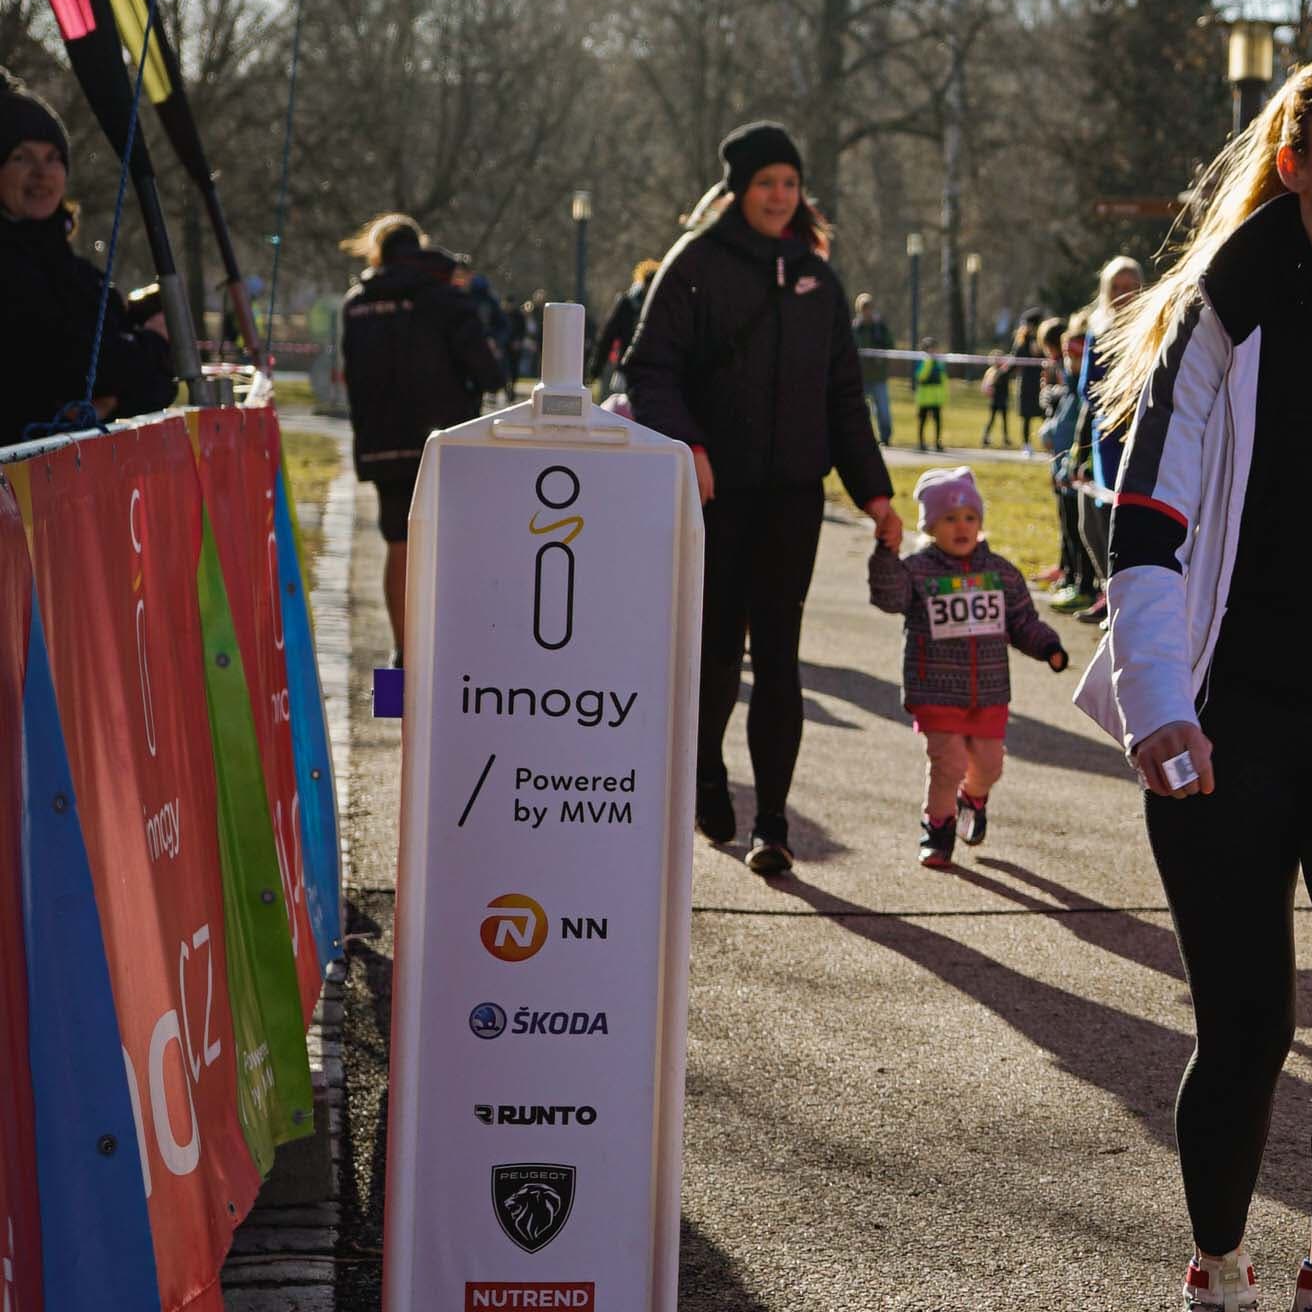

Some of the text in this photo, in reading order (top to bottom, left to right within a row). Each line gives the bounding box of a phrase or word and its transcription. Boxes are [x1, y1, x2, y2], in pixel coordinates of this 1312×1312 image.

[932, 594, 999, 625] 3065
[462, 674, 638, 727] innogy
[515, 767, 636, 793] Powered
[513, 798, 632, 829] by MVM
[560, 917, 608, 939] NN
[511, 1006, 609, 1035] ŠKODA
[498, 1105, 597, 1126] RUNTO
[499, 1171, 569, 1181] PEUGEOT
[472, 1289, 589, 1308] NUTREND
